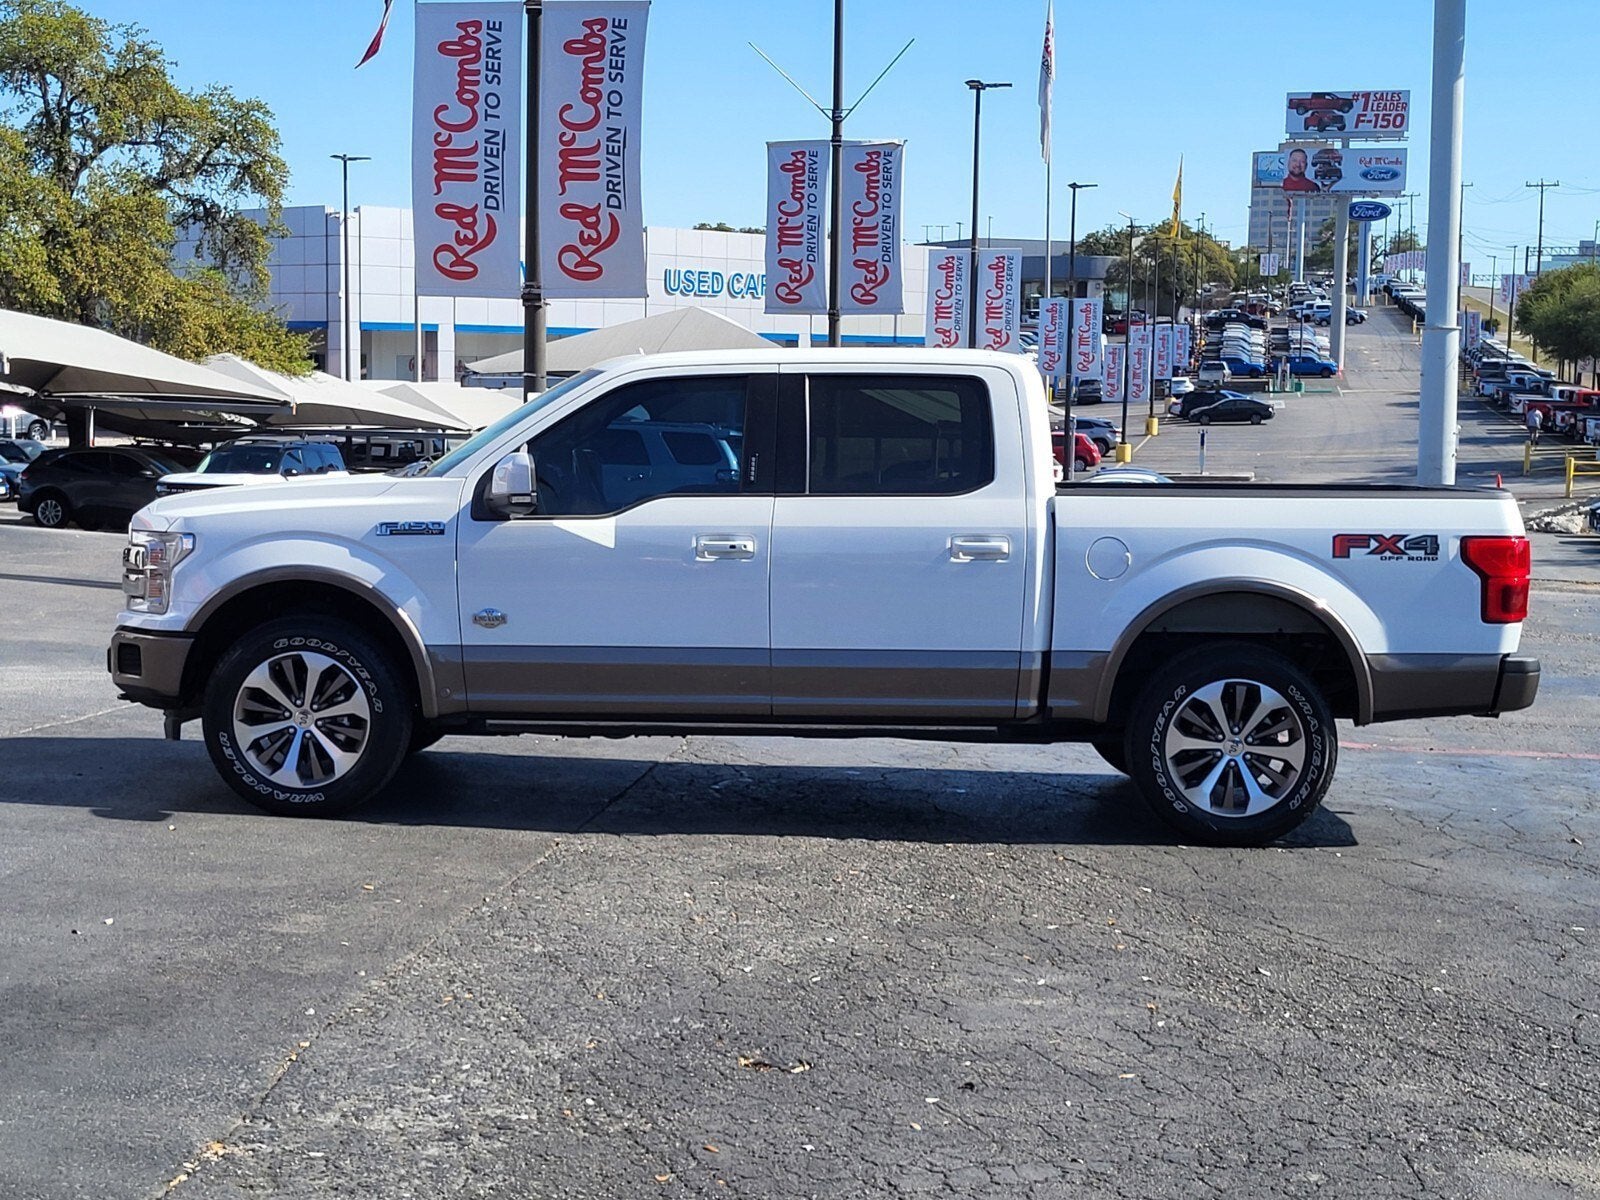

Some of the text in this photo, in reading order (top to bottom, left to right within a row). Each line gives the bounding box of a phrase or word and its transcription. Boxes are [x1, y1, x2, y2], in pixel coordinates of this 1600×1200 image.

[484, 20, 503, 211] DRIVEN TO SERVE
[606, 17, 628, 210] DRIVEN TO SERVE
[1352, 92, 1402, 112] #1 SALES
[1354, 113, 1405, 129] F-150
[1371, 102, 1408, 112] LEADER
[433, 19, 498, 281] Red McCombs
[558, 17, 621, 281] Red McCombs
[1367, 169, 1392, 179] Ford
[775, 150, 814, 304] Red McCombs
[806, 150, 819, 263] DRIVEN TO SERVE
[850, 150, 890, 306] Red McCombs
[882, 150, 894, 263] DRIVEN TO SERVE
[1352, 204, 1382, 217] Ford
[664, 268, 724, 296] USED
[934, 255, 956, 325] McCombs
[954, 255, 964, 331] DRIVEN TO SERVE
[985, 255, 1006, 325] McCombs
[1004, 255, 1014, 331] DRIVEN TO SERVE
[1042, 350, 1061, 372] Red
[1076, 351, 1094, 372] Red
[1332, 534, 1440, 558] FX4
[274, 636, 383, 714] GOODYEAR
[219, 731, 325, 803] WRANGLER
[1151, 684, 1189, 814] GOODYEAR
[1287, 684, 1322, 810] WRANGLER
